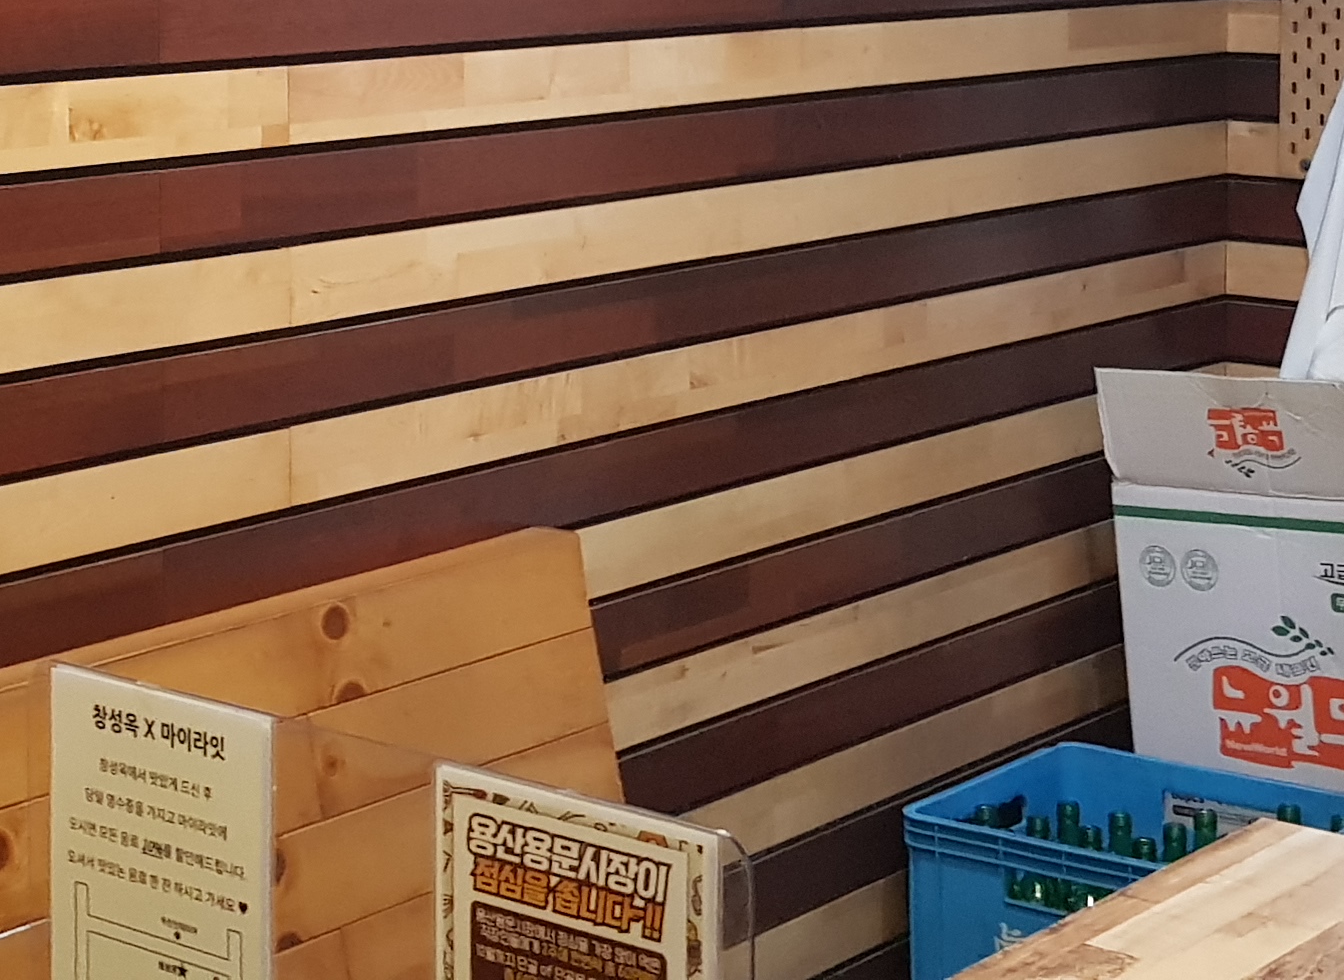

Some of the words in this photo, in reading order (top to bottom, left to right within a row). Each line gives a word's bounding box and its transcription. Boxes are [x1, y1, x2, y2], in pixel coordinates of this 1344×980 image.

[92, 704, 140, 739] 창성옥
[160, 722, 226, 762] 마이라잇
[468, 814, 672, 902] 용산용문시장이
[471, 856, 551, 908] 점심을
